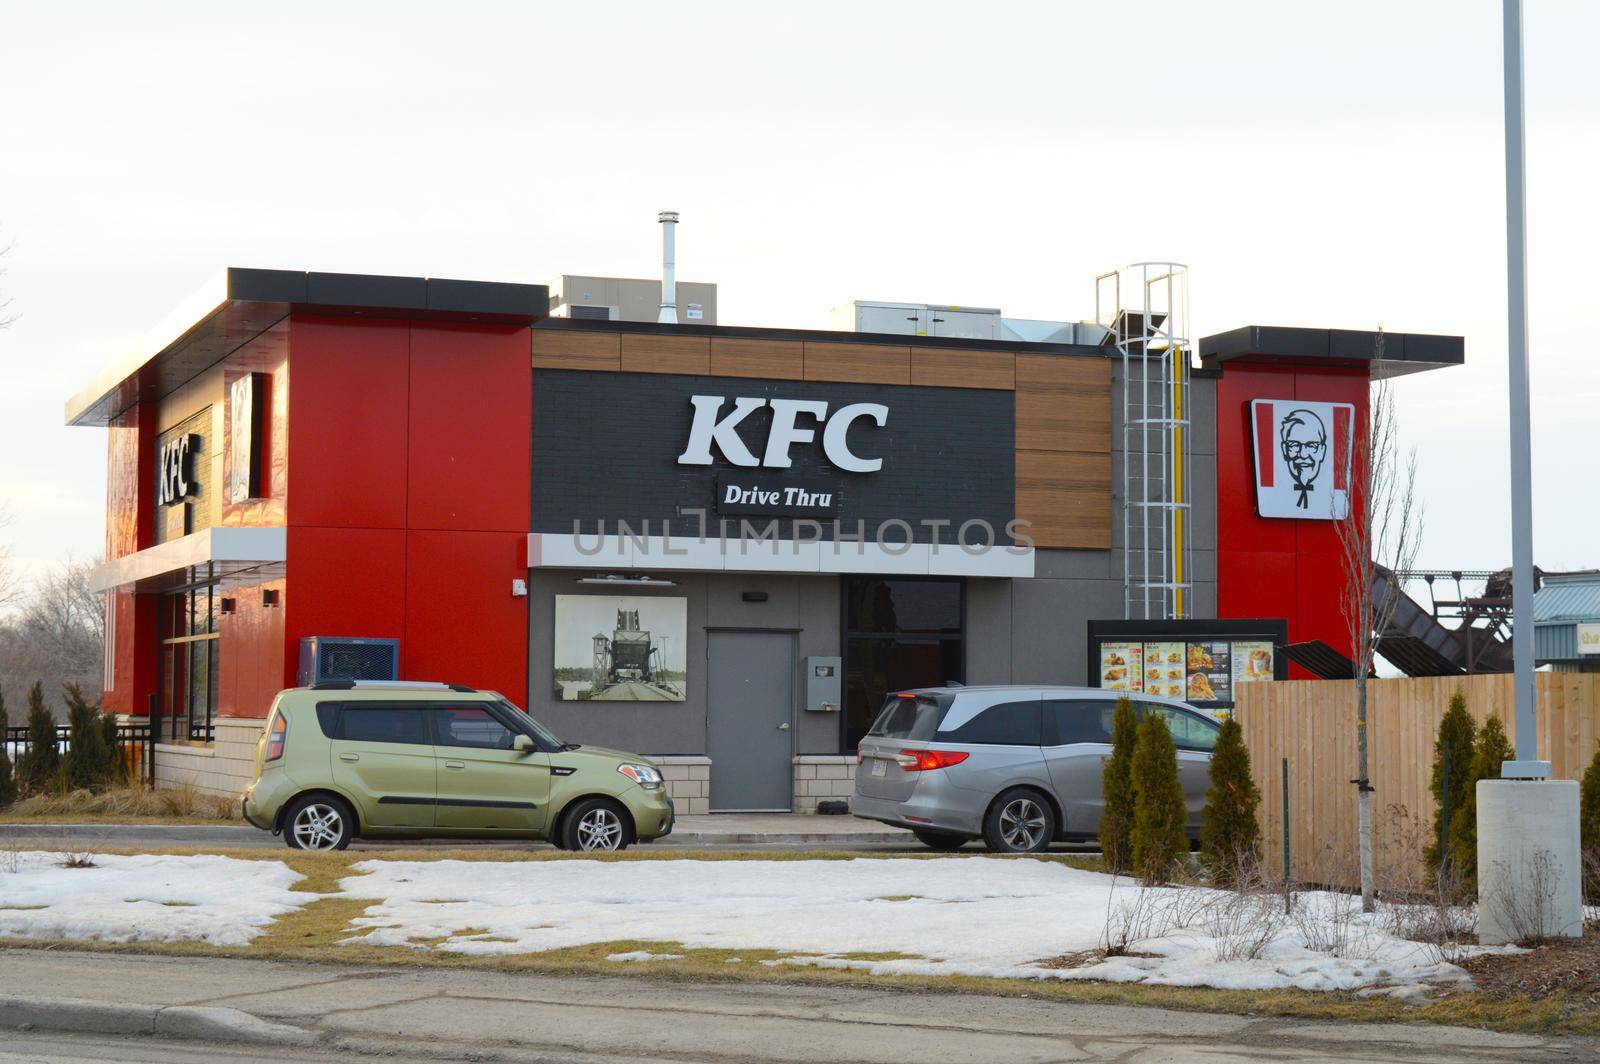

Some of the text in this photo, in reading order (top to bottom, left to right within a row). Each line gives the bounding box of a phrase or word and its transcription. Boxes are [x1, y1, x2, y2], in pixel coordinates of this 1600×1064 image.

[158, 432, 189, 505] KFC
[677, 394, 889, 473] KFC
[723, 485, 833, 507] Drive Thru
